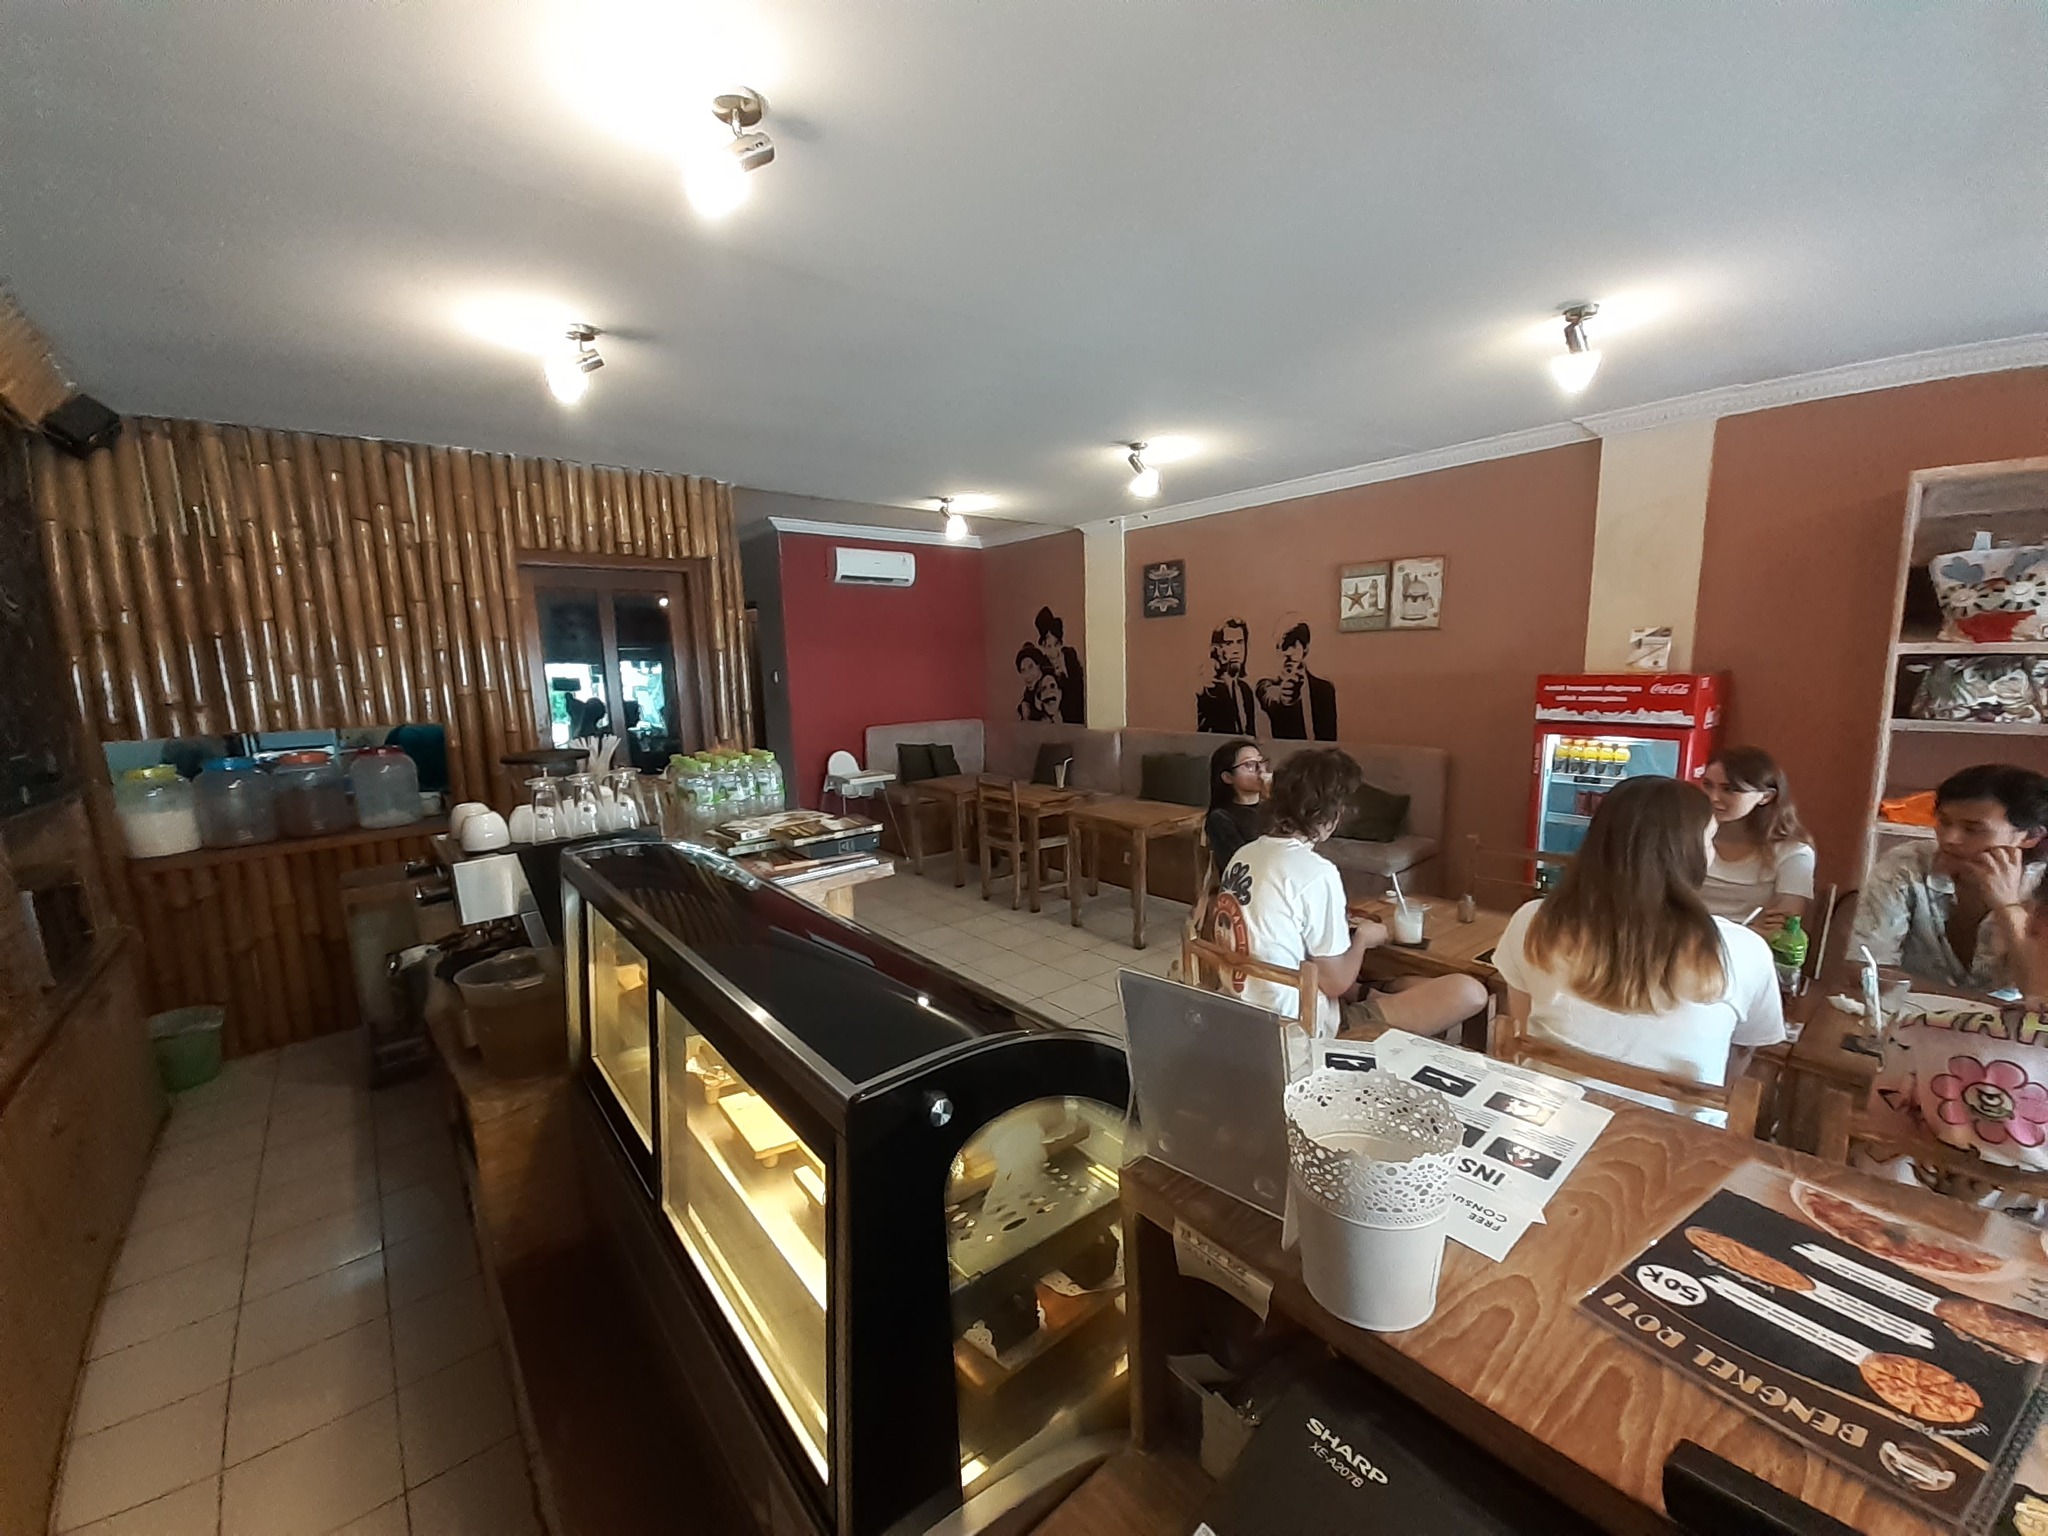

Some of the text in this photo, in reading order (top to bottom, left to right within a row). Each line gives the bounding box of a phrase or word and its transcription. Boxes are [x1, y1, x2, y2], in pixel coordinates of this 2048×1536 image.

[1467, 1212, 1501, 1232] FREE
[1643, 1269, 1699, 1303] 50K
[1602, 1292, 1687, 1348] ROTI
[1692, 1345, 1869, 1449] BENGKEL
[1306, 1416, 1389, 1486] SHARP
